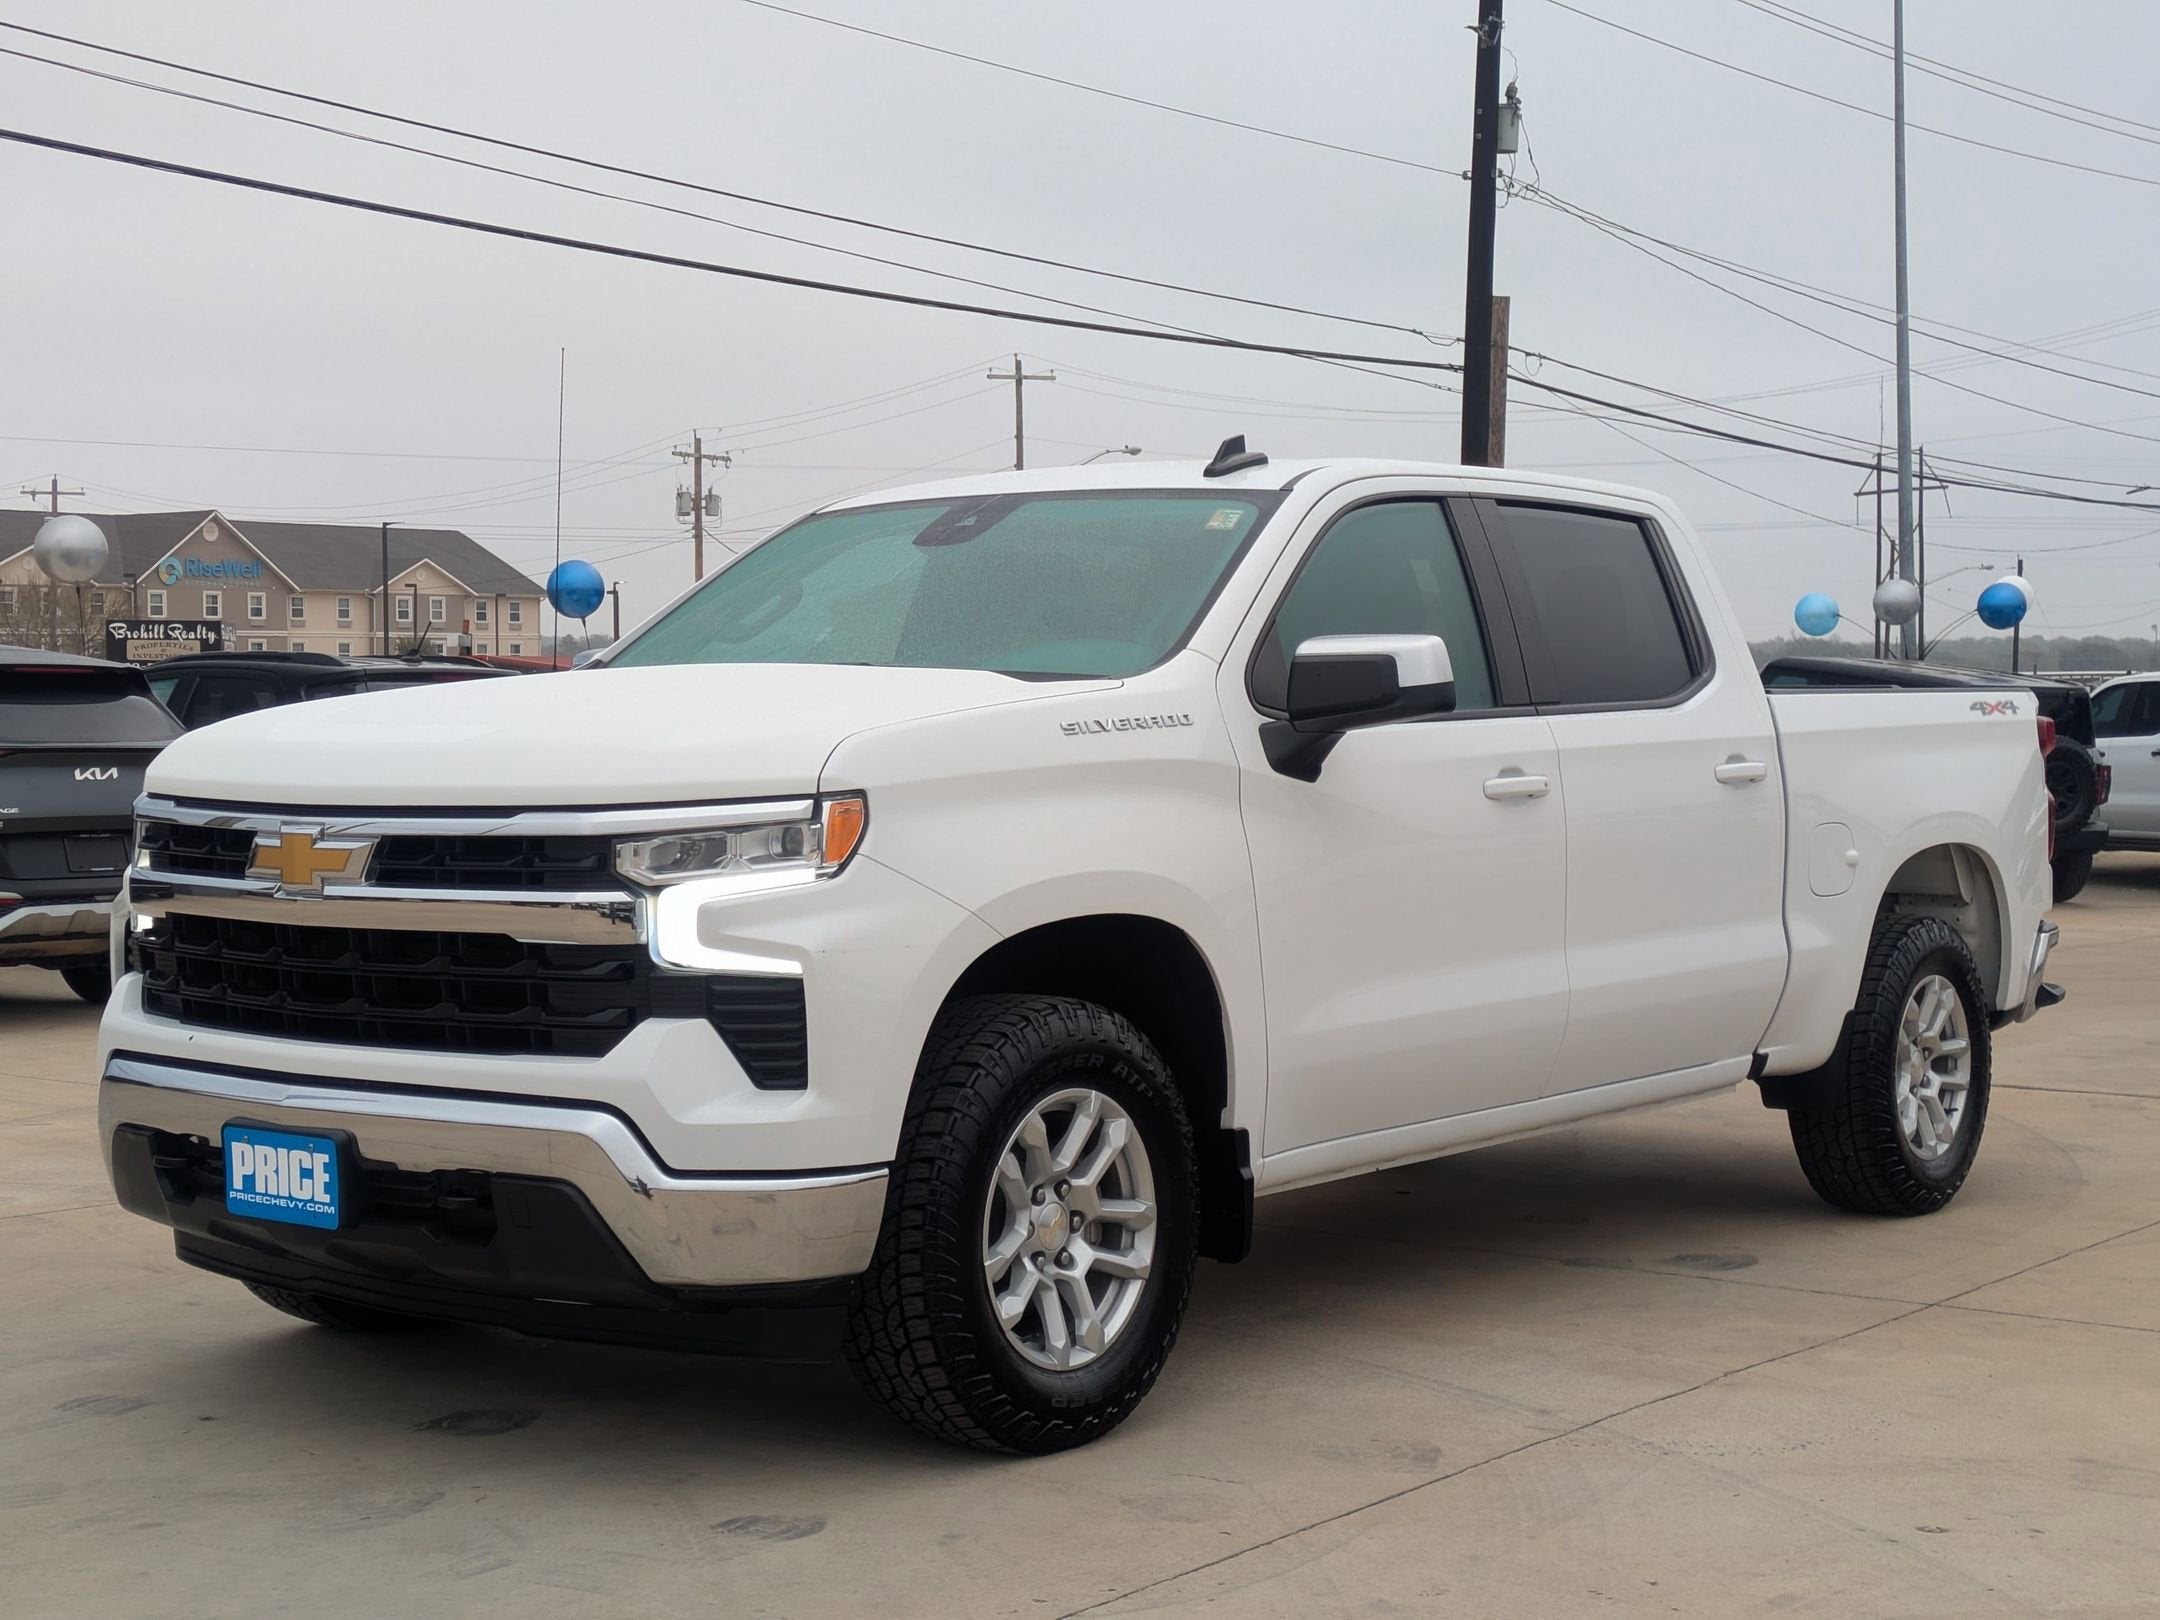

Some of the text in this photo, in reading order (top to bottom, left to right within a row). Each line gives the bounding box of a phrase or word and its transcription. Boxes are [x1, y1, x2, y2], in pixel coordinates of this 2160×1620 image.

[185, 558, 262, 578] RiseWell
[109, 622, 165, 640] Brohill
[167, 623, 216, 645] Realty
[134, 641, 194, 652] PROPERTIES
[1060, 713, 1194, 736] SILVERADO
[74, 767, 118, 780] KIA
[231, 1141, 331, 1203] PRICE
[229, 1191, 335, 1214] PRICECHEVY.COM
